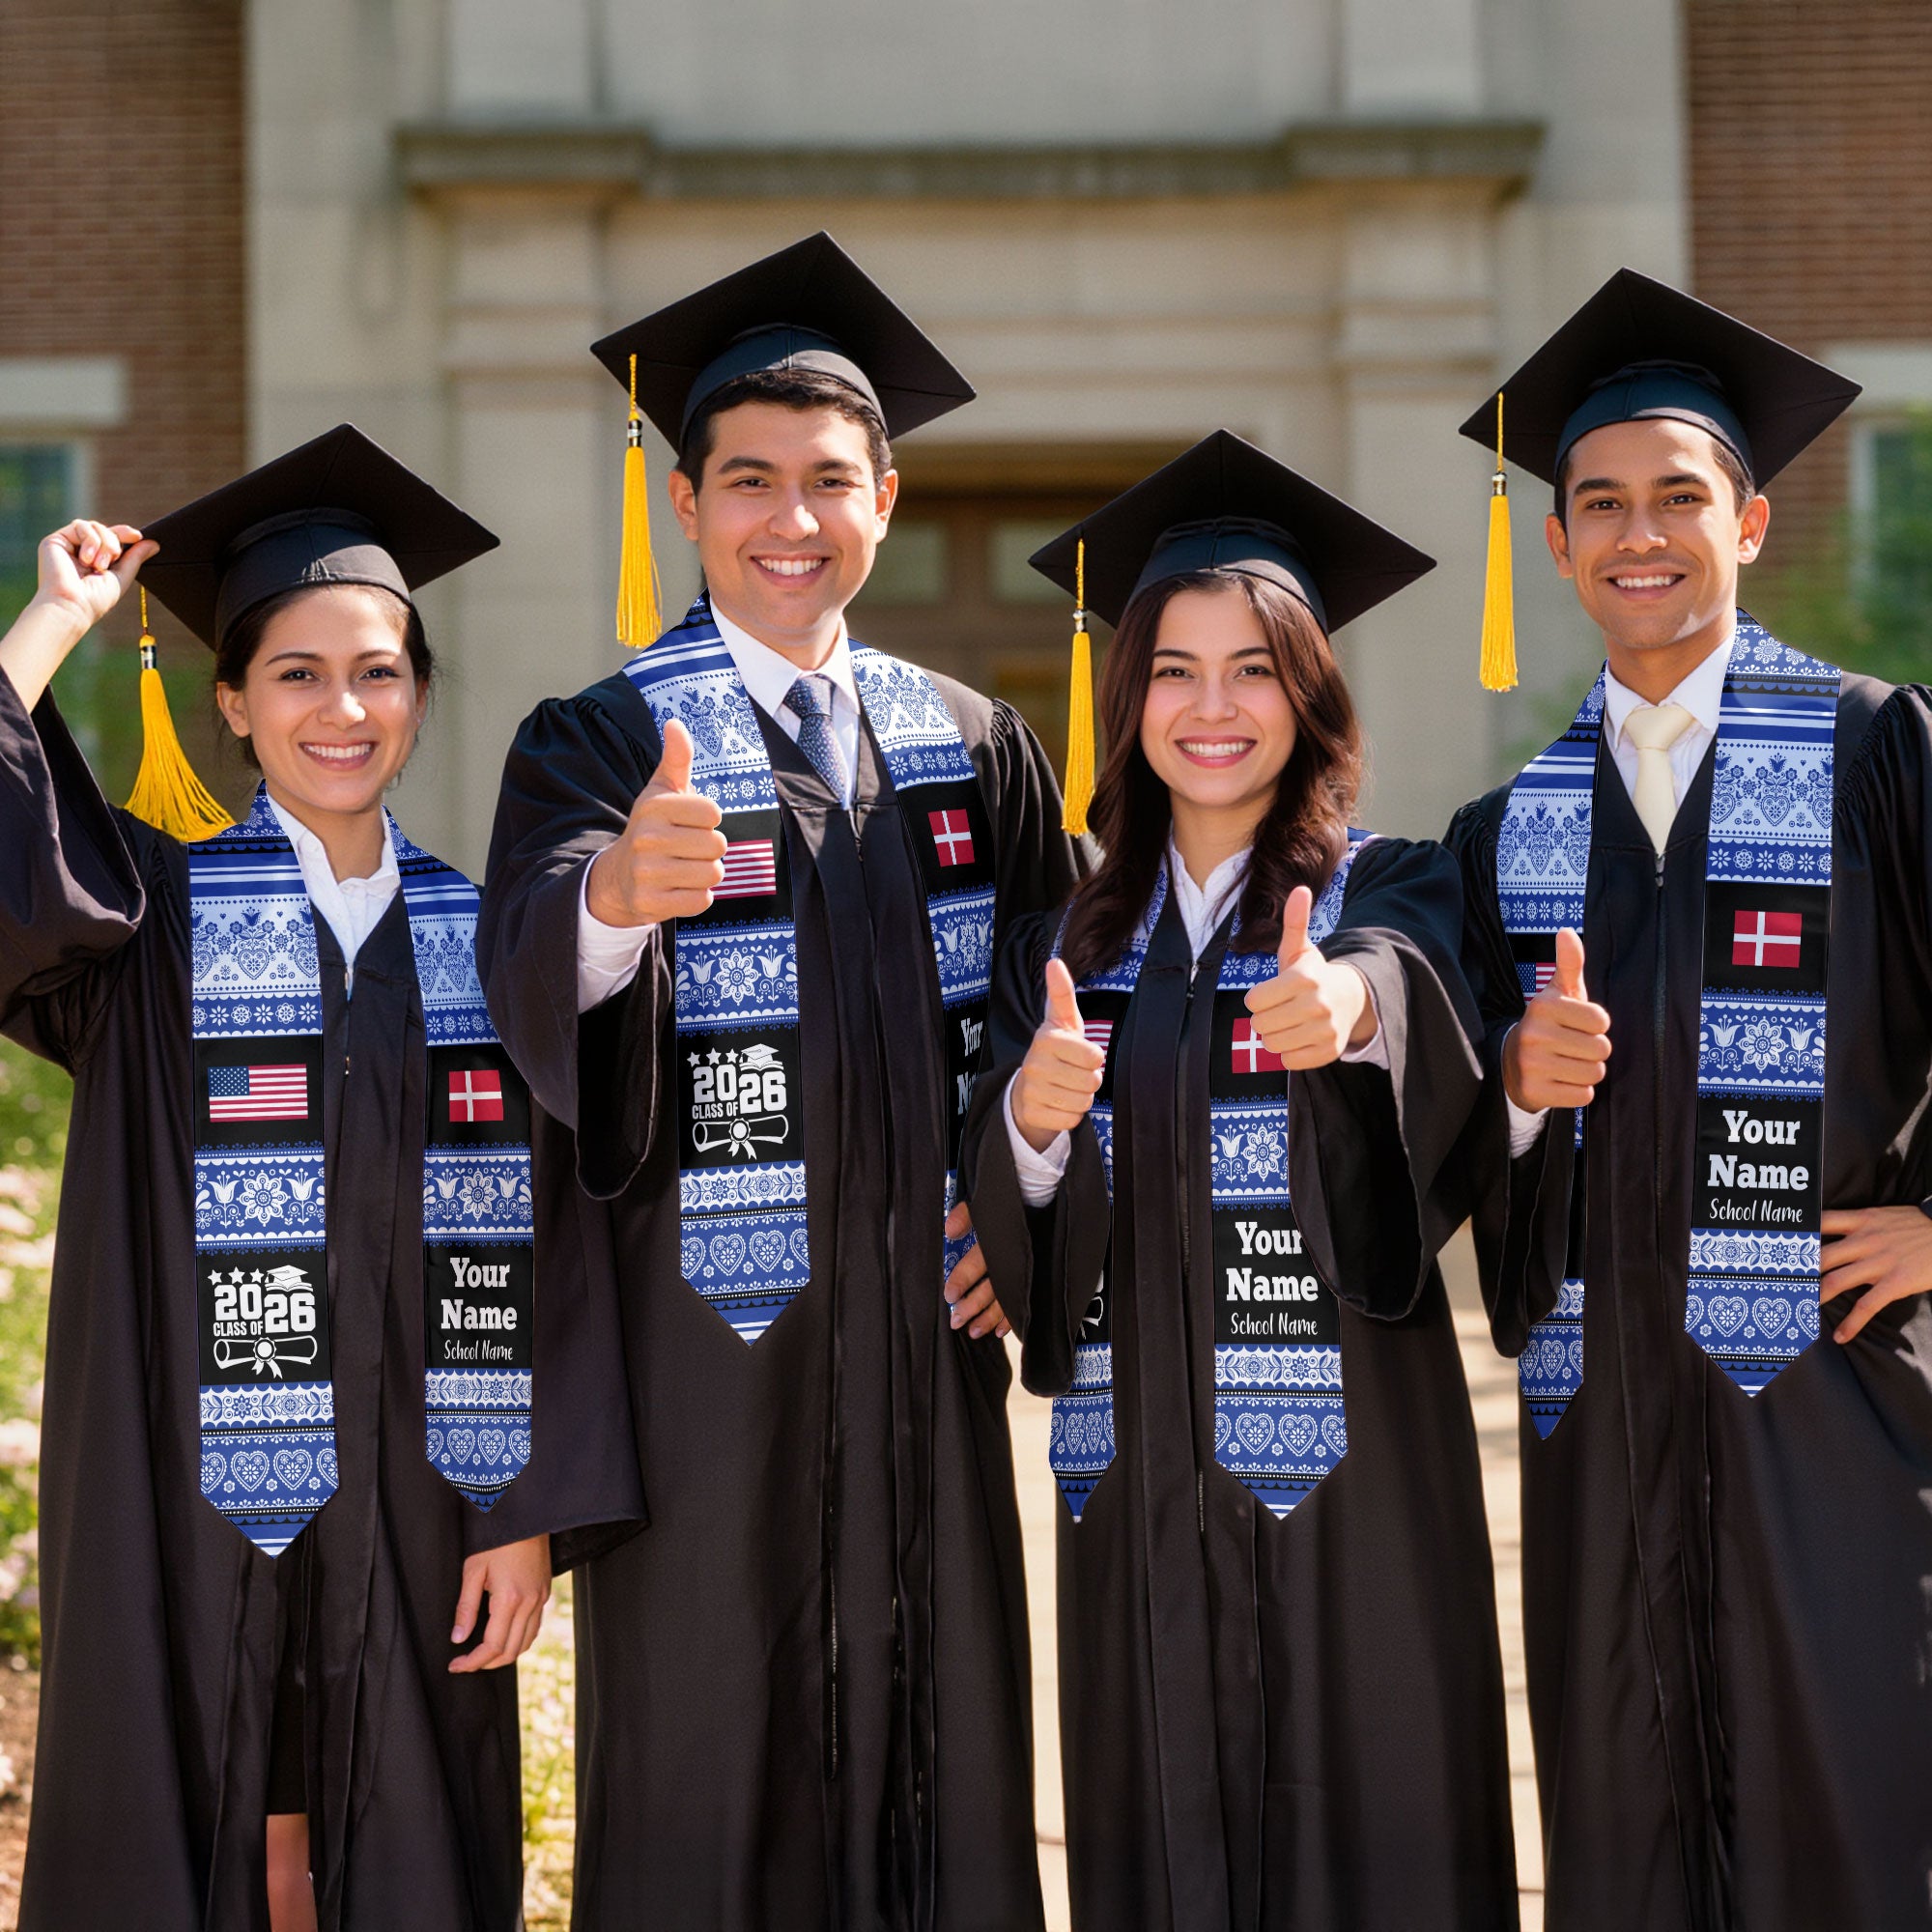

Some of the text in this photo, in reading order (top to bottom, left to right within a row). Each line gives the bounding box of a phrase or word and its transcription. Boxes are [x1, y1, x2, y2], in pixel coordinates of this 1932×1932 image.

[960, 1017, 983, 1057] Your
[692, 1064, 787, 1115] 2026
[692, 1101, 739, 1120] CLASS OF
[1721, 1109, 1801, 1146] Your
[1707, 1153, 1809, 1191] Name
[1709, 1197, 1803, 1223] School Name
[1235, 1221, 1303, 1256] Your
[449, 1257, 511, 1289] Your
[1225, 1266, 1320, 1302] Name
[213, 1283, 317, 1333] 2026
[440, 1298, 518, 1331] Name
[1230, 1312, 1319, 1336] School Name
[213, 1320, 264, 1337] CLASS OF
[443, 1339, 513, 1361] School Name
